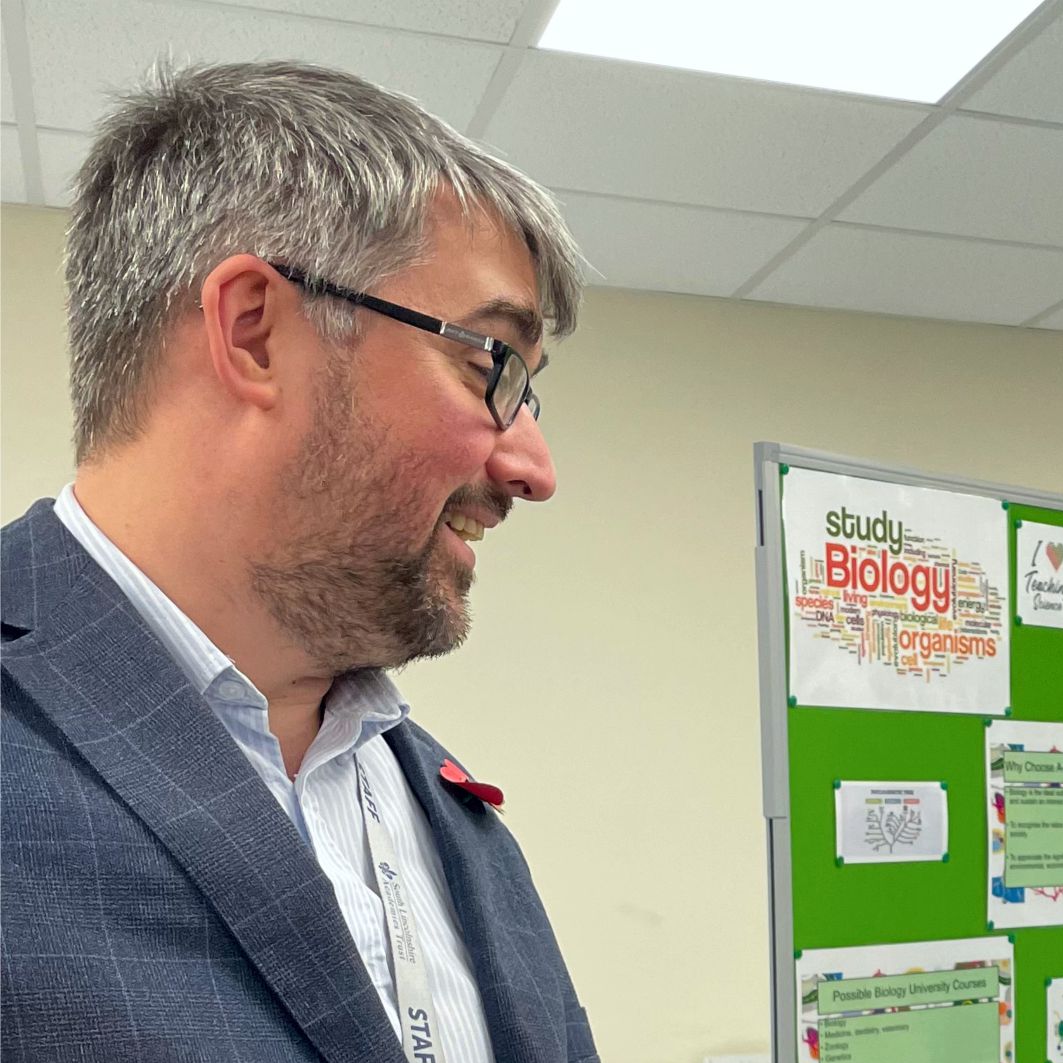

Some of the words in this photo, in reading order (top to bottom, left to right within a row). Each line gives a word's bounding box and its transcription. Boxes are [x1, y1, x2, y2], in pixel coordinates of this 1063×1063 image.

[826, 507, 903, 555] study
[1031, 540, 1043, 567] I
[825, 542, 951, 613] Biology
[795, 596, 833, 610] species
[843, 590, 868, 608] living
[958, 600, 984, 613] energy
[816, 611, 834, 622] DNA
[845, 615, 864, 625] cells
[900, 630, 997, 659] organisms
[1005, 761, 1022, 774] Why
[1025, 761, 1054, 772] Choose
[833, 987, 872, 1001] Possible
[875, 985, 906, 999] Biology
[909, 982, 950, 995] University
[952, 979, 986, 990] Courses
